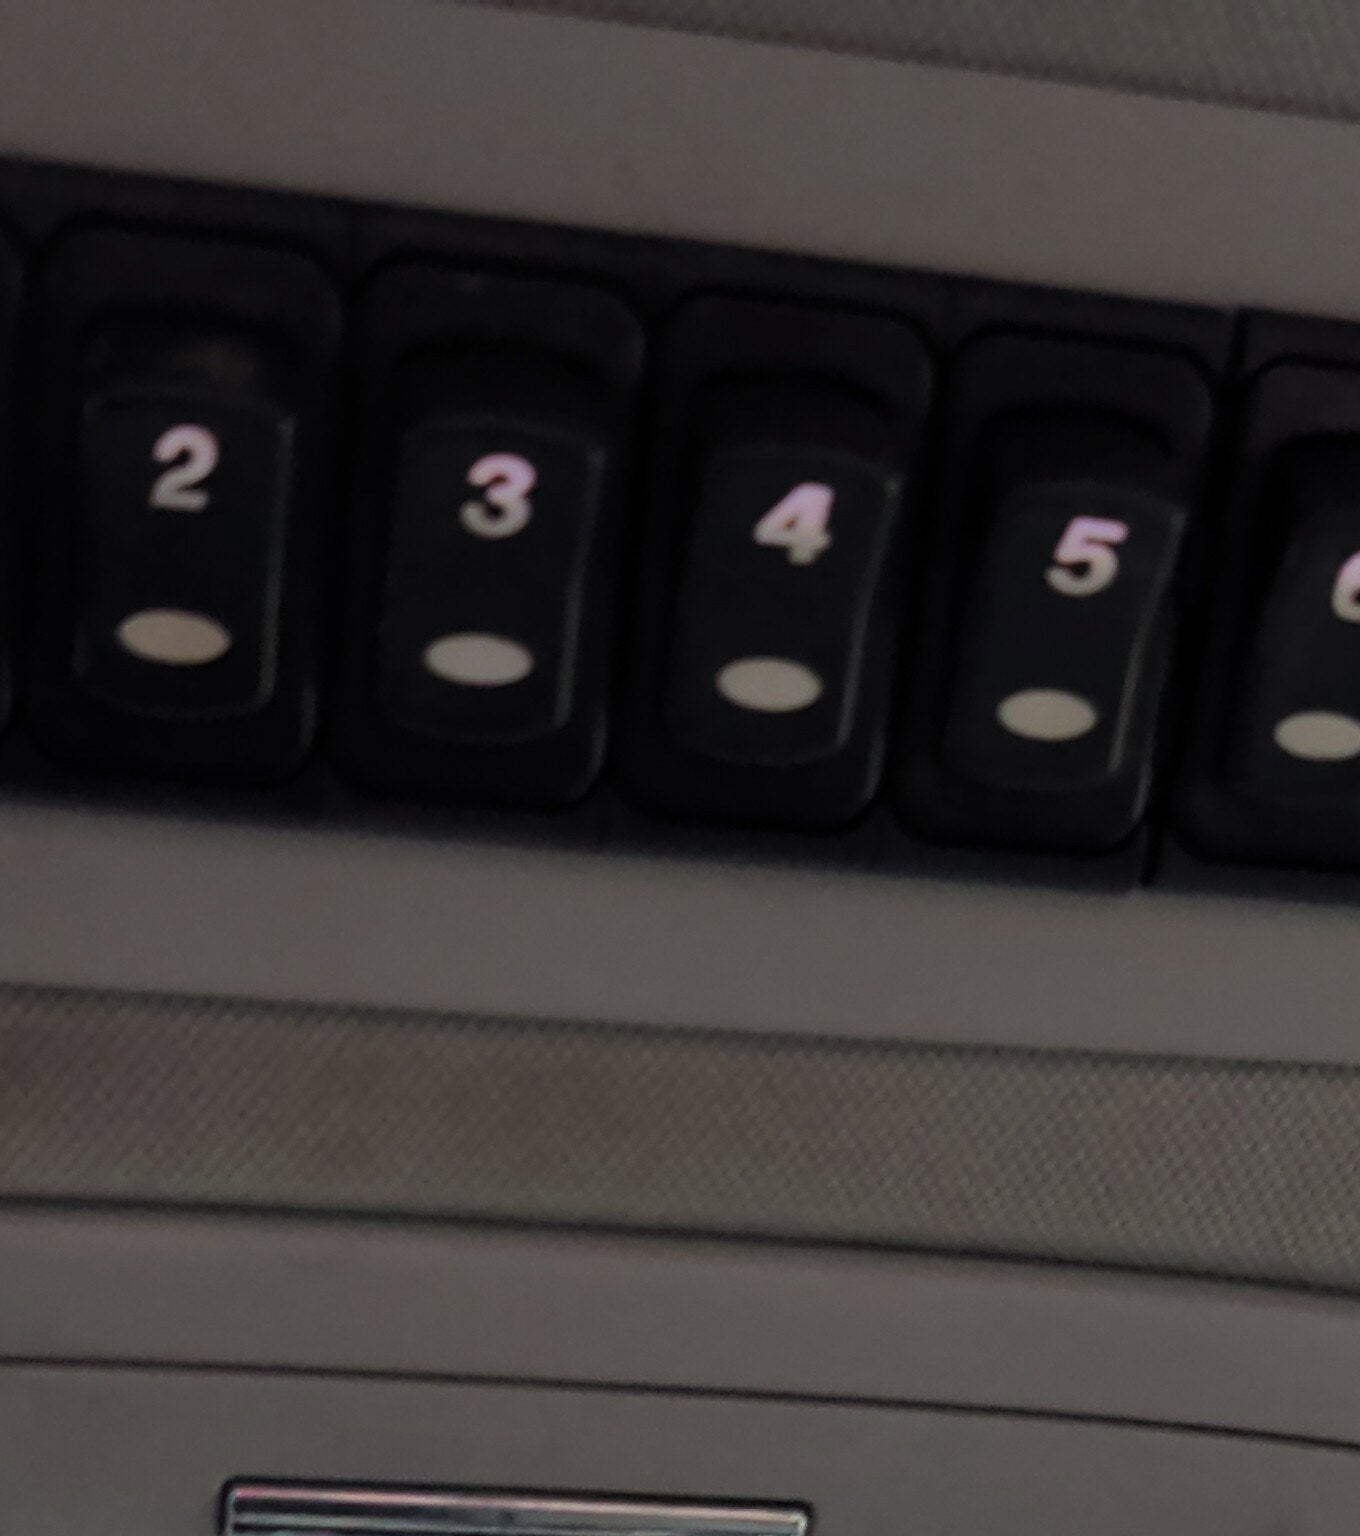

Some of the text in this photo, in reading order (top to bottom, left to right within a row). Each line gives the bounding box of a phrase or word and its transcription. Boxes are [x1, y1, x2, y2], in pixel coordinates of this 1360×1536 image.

[150, 424, 219, 511] 2
[460, 452, 537, 539] 3
[753, 482, 835, 566] 4
[1046, 516, 1128, 597] 5
